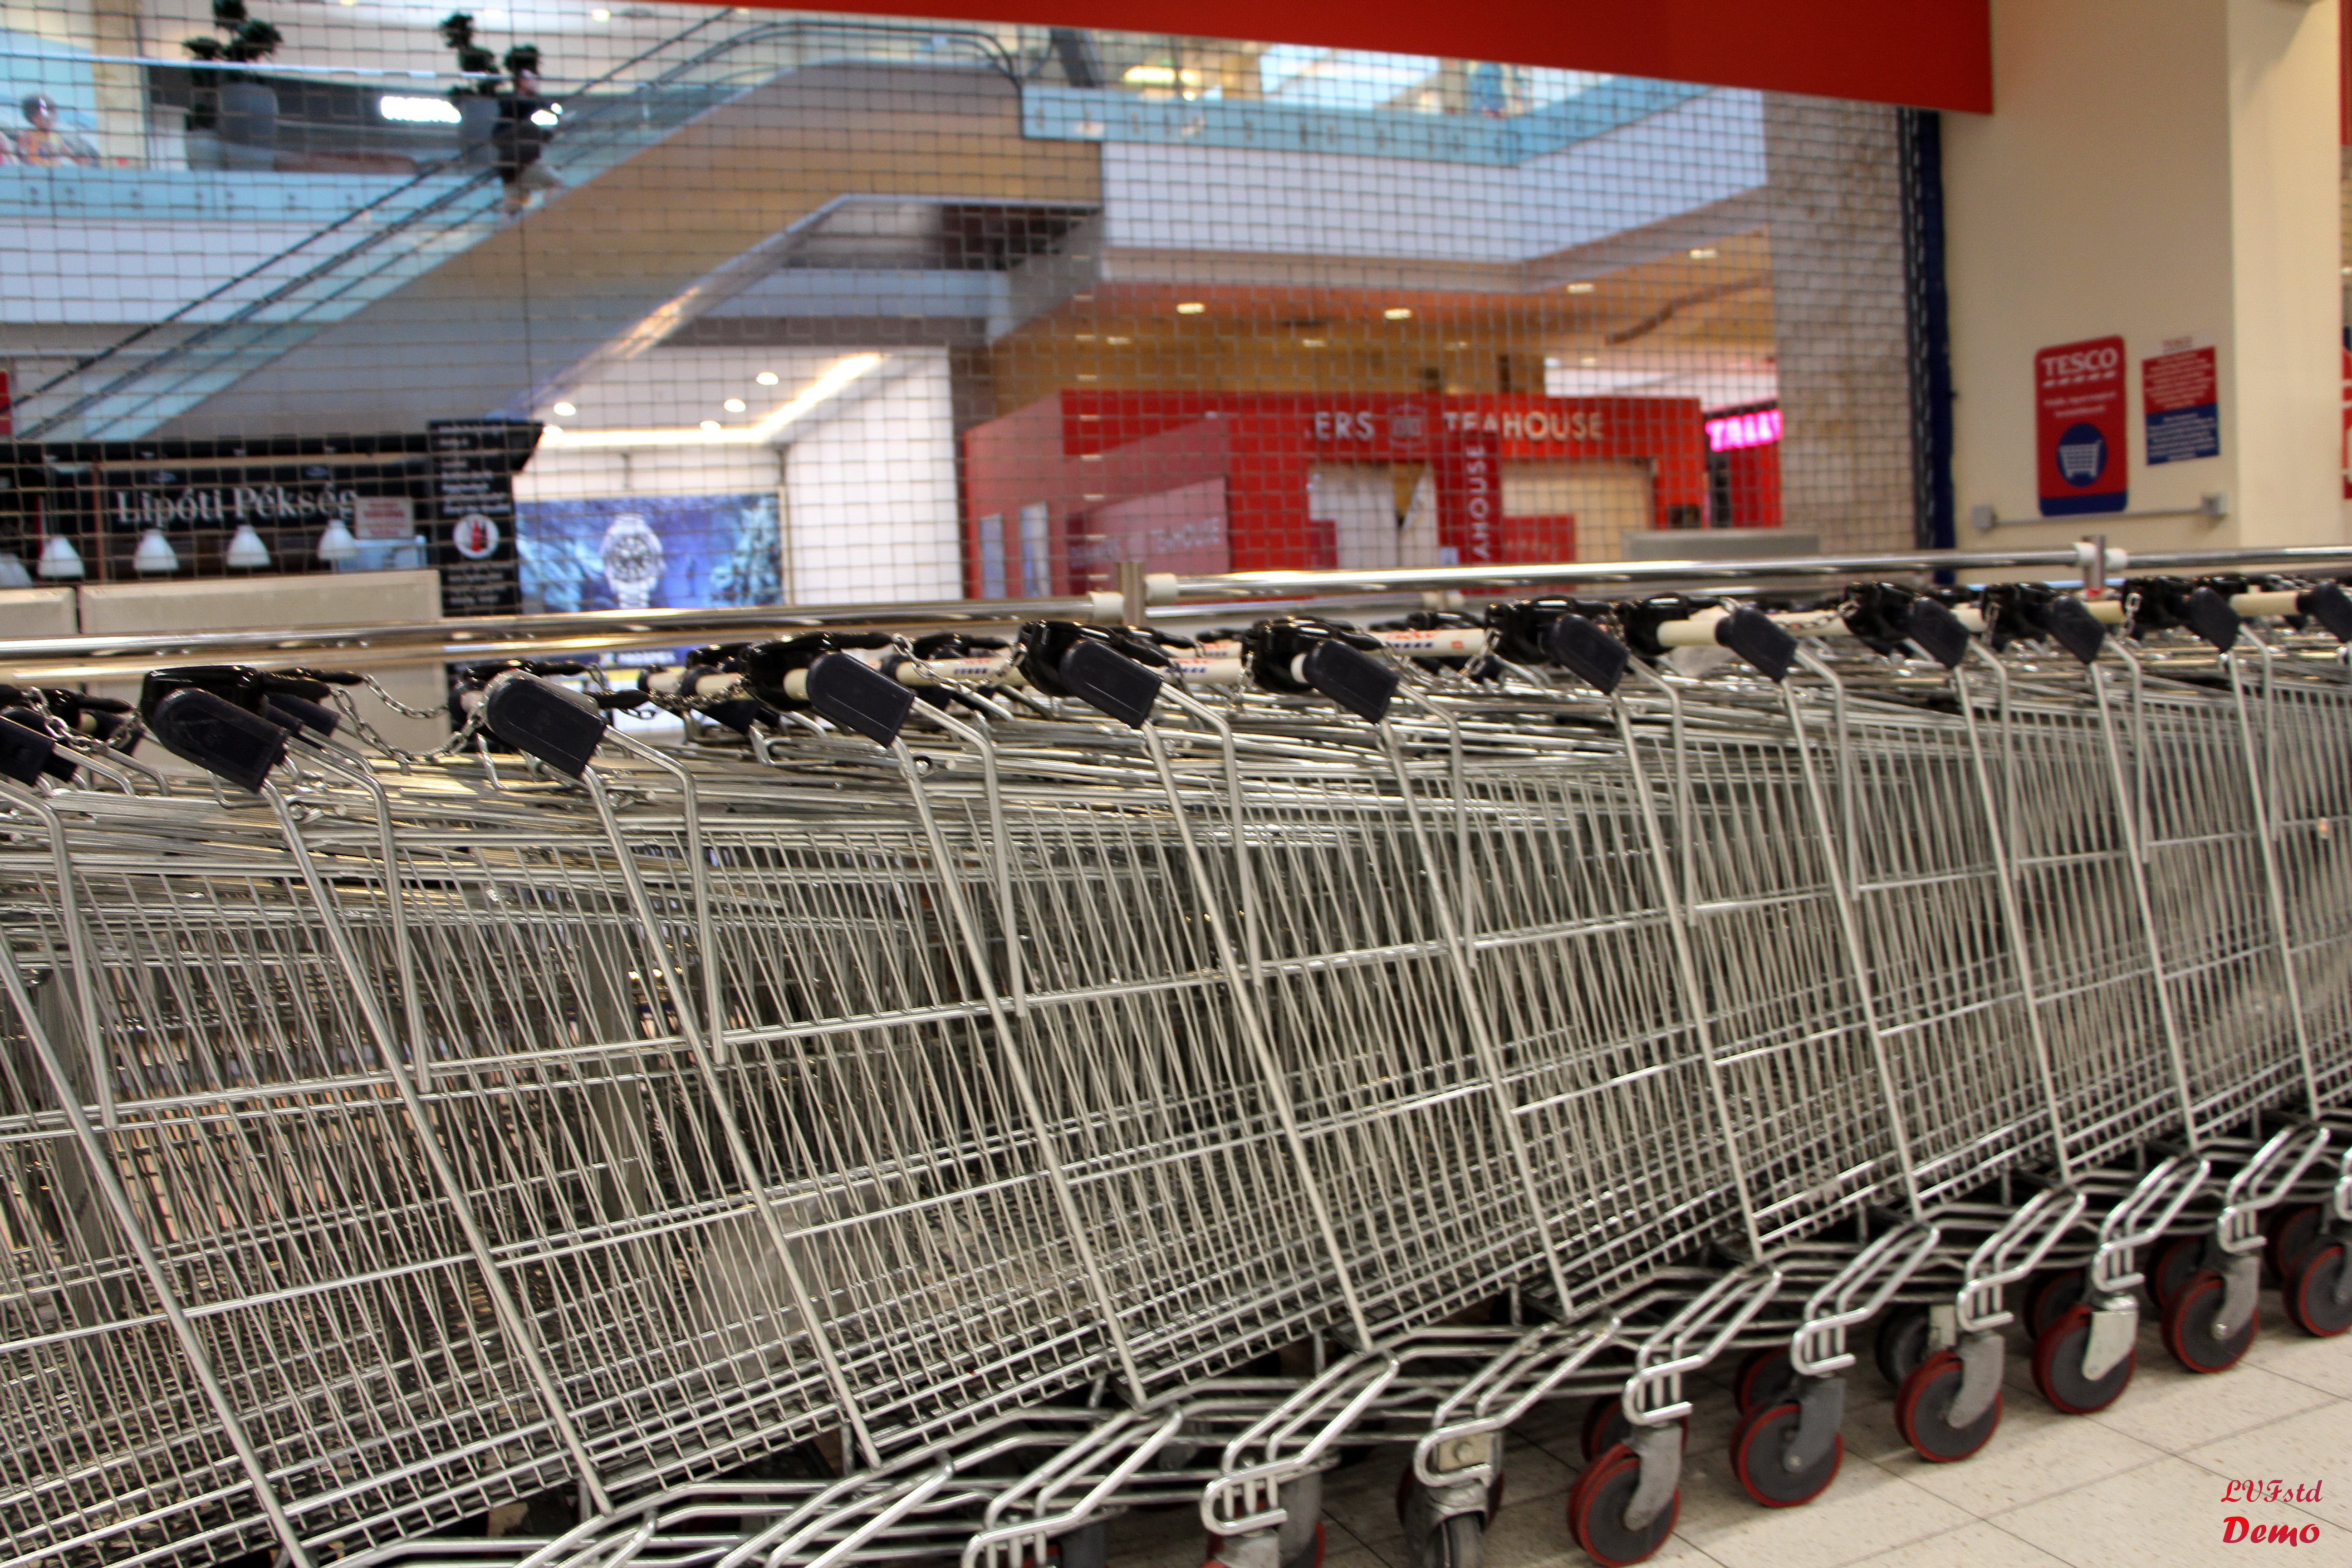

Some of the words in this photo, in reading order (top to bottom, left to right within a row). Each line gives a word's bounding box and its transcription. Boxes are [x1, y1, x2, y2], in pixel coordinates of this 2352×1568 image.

[2042, 348, 2117, 377] TESCO
[1303, 410, 1375, 441] ERS
[1442, 411, 1603, 441] TEAHOUSE
